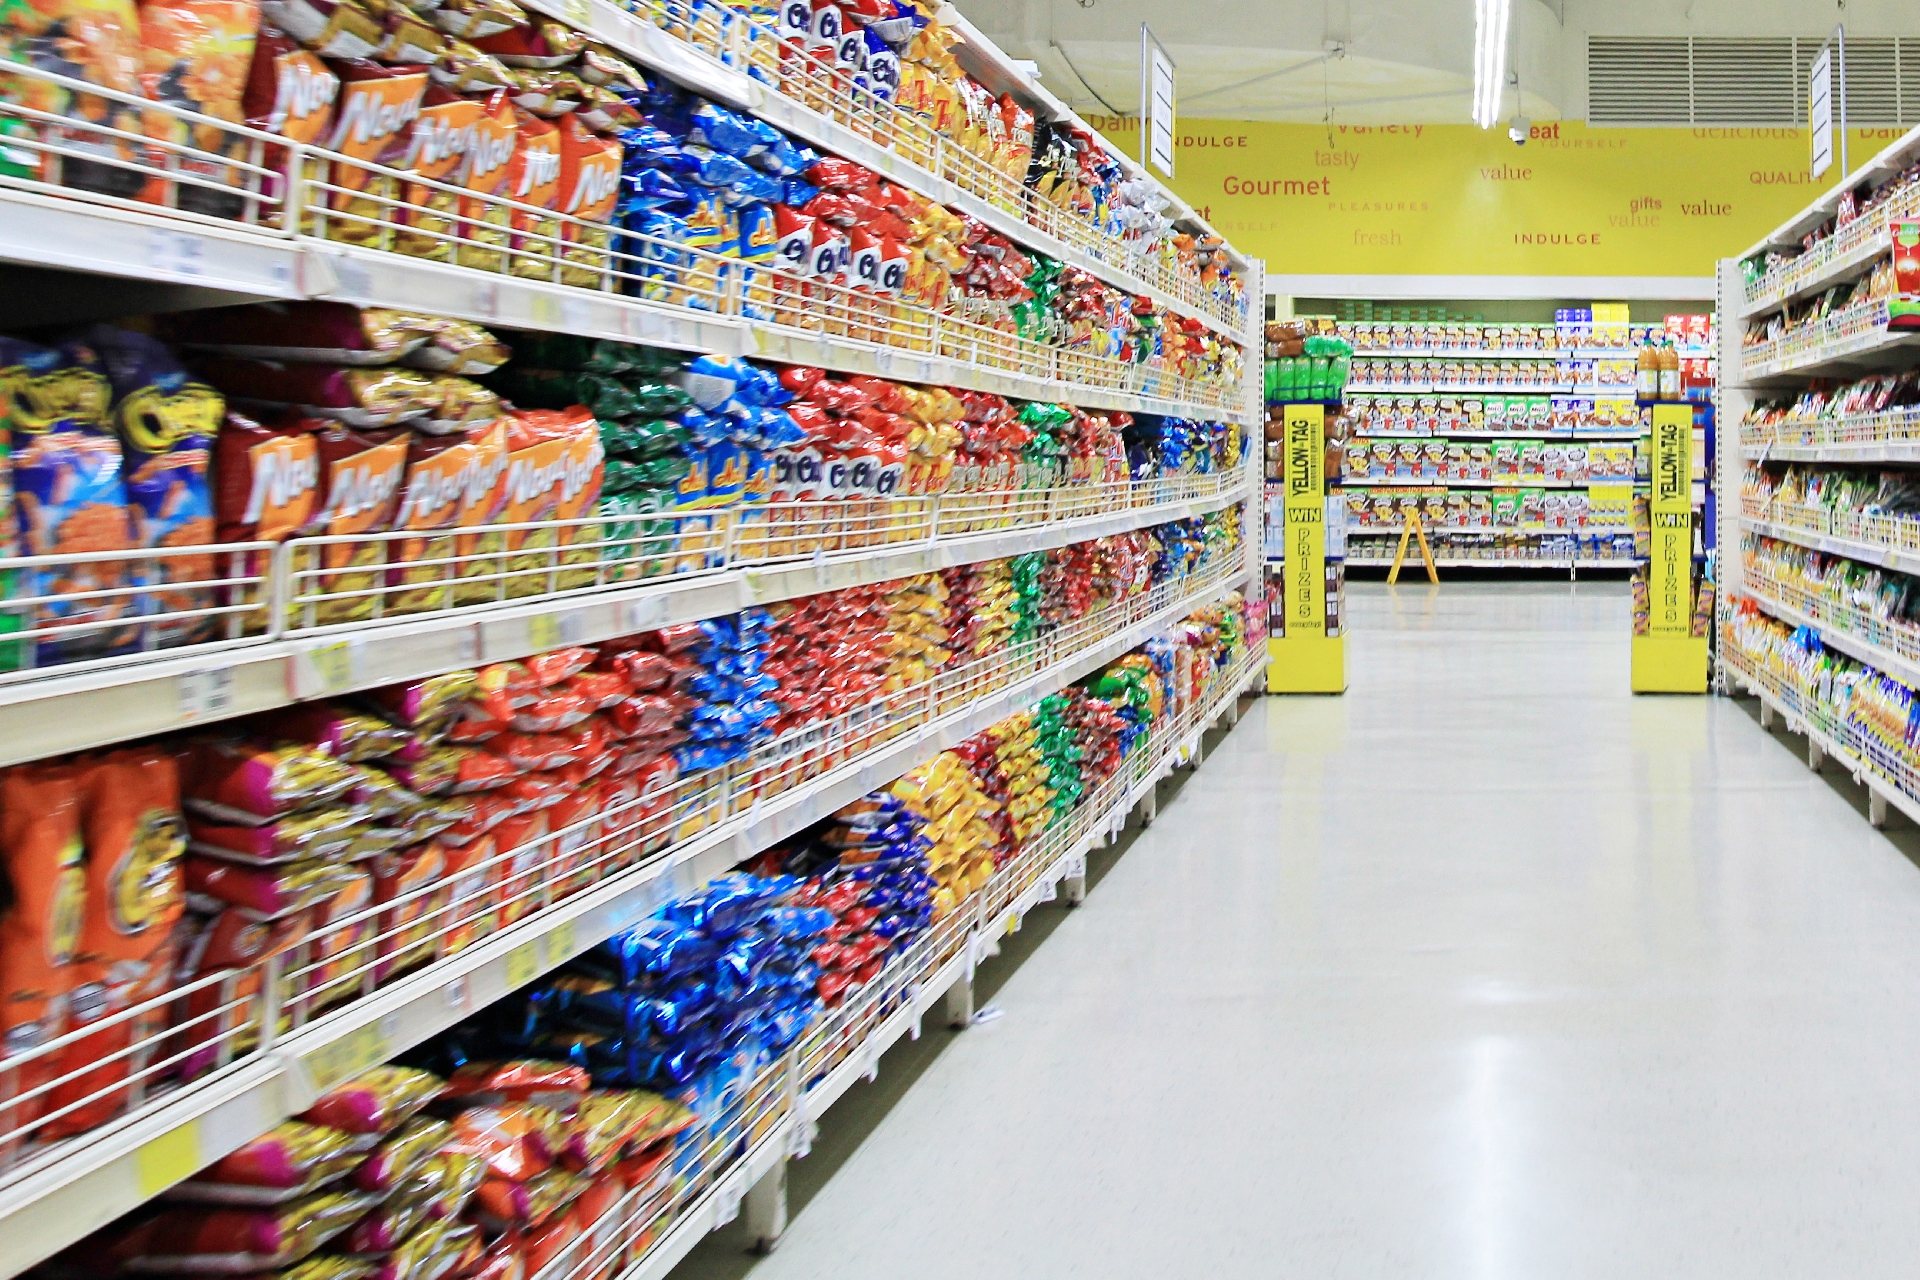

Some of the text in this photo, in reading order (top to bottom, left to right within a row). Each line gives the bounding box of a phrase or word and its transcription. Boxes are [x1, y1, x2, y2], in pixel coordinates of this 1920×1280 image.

[1530, 122, 1560, 139] eat
[1860, 128, 1909, 139] Dail
[1541, 139, 1628, 149] YOURSELF
[1314, 150, 1360, 171] tasty
[1480, 163, 1532, 181] value
[1223, 176, 1331, 196] Gourmet
[1328, 202, 1429, 211] PLEASURES
[1630, 196, 1662, 214] gifts
[1681, 199, 1732, 216] value
[1608, 211, 1660, 228] value
[1353, 229, 1402, 246] fresh
[1514, 233, 1601, 245] INDULGE
[1292, 419, 1309, 497] YELLOW-TAG
[1660, 424, 1678, 502] YELLOW-TAG
[1289, 508, 1322, 523] WIN
[1655, 513, 1688, 528] WIN
[1298, 528, 1311, 618] PRIZES
[1664, 534, 1677, 622] PRIZES
